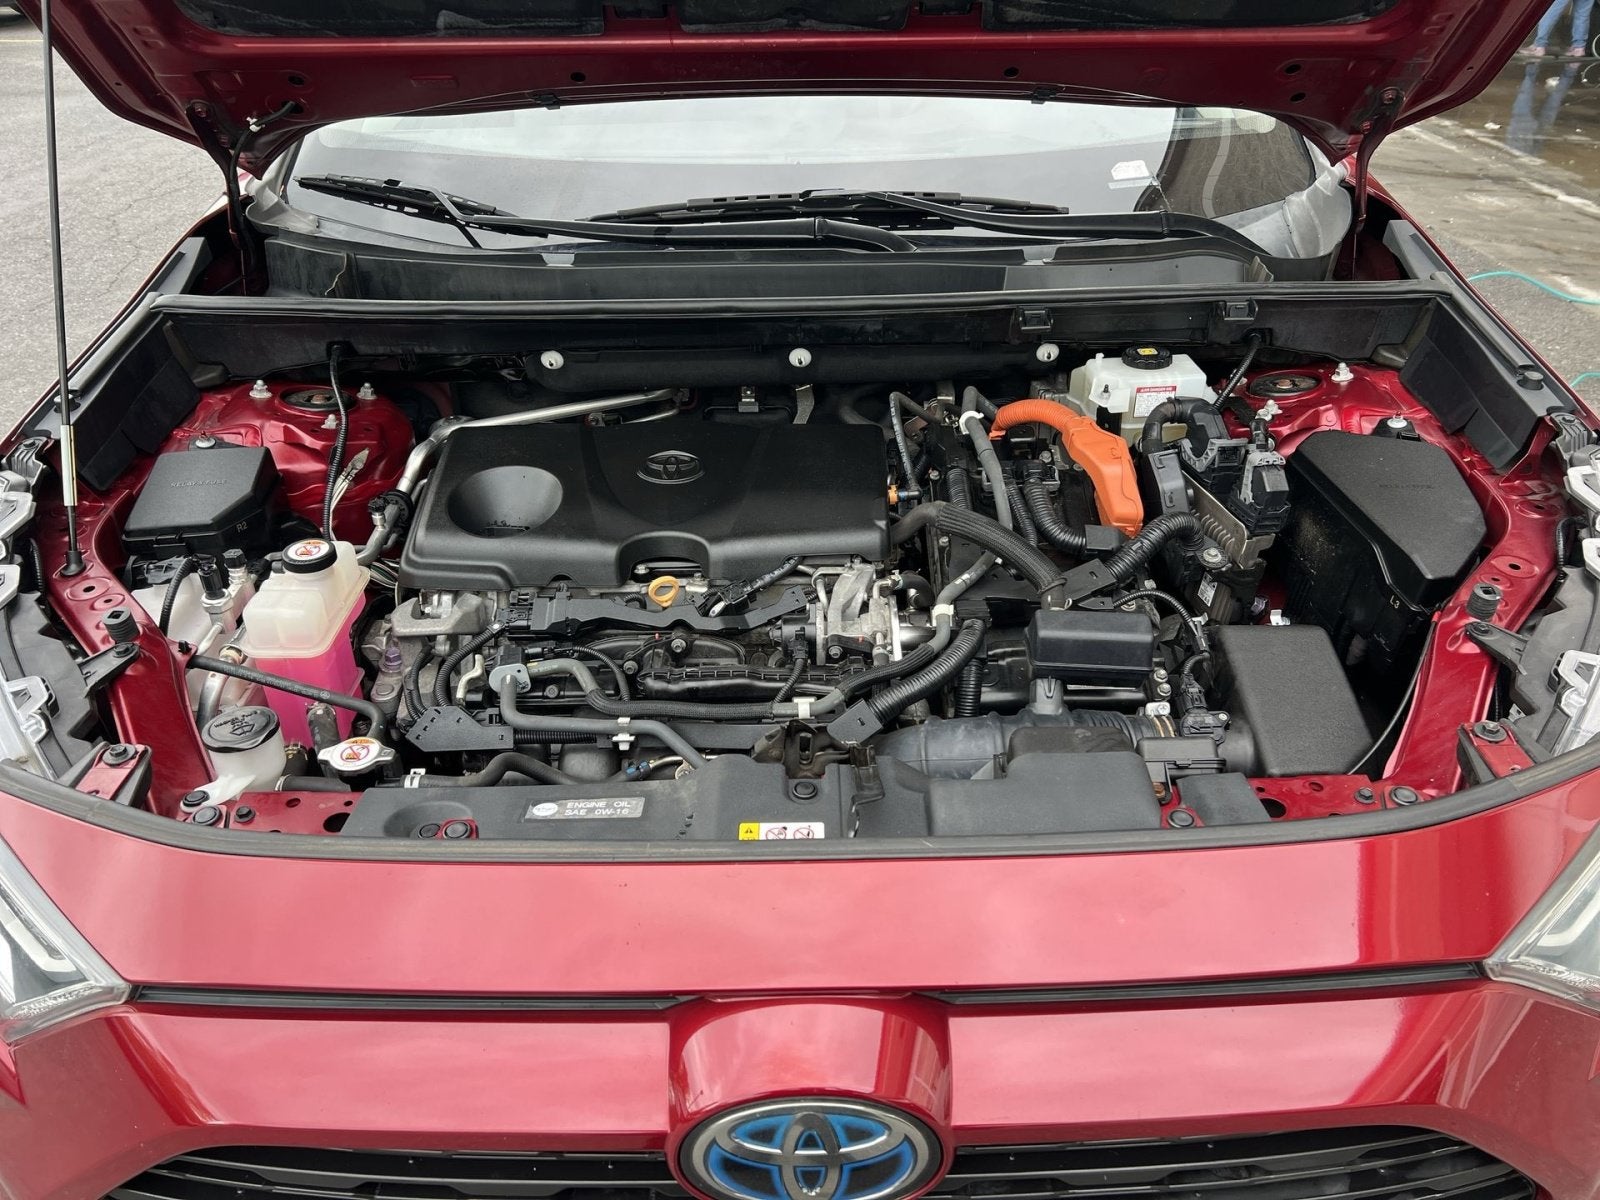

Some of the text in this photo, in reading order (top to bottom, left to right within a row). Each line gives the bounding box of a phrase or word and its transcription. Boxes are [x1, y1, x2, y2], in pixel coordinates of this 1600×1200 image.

[236, 521, 248, 532] R2
[1390, 595, 1400, 608] L3
[566, 800, 631, 809] ENGINE OIL
